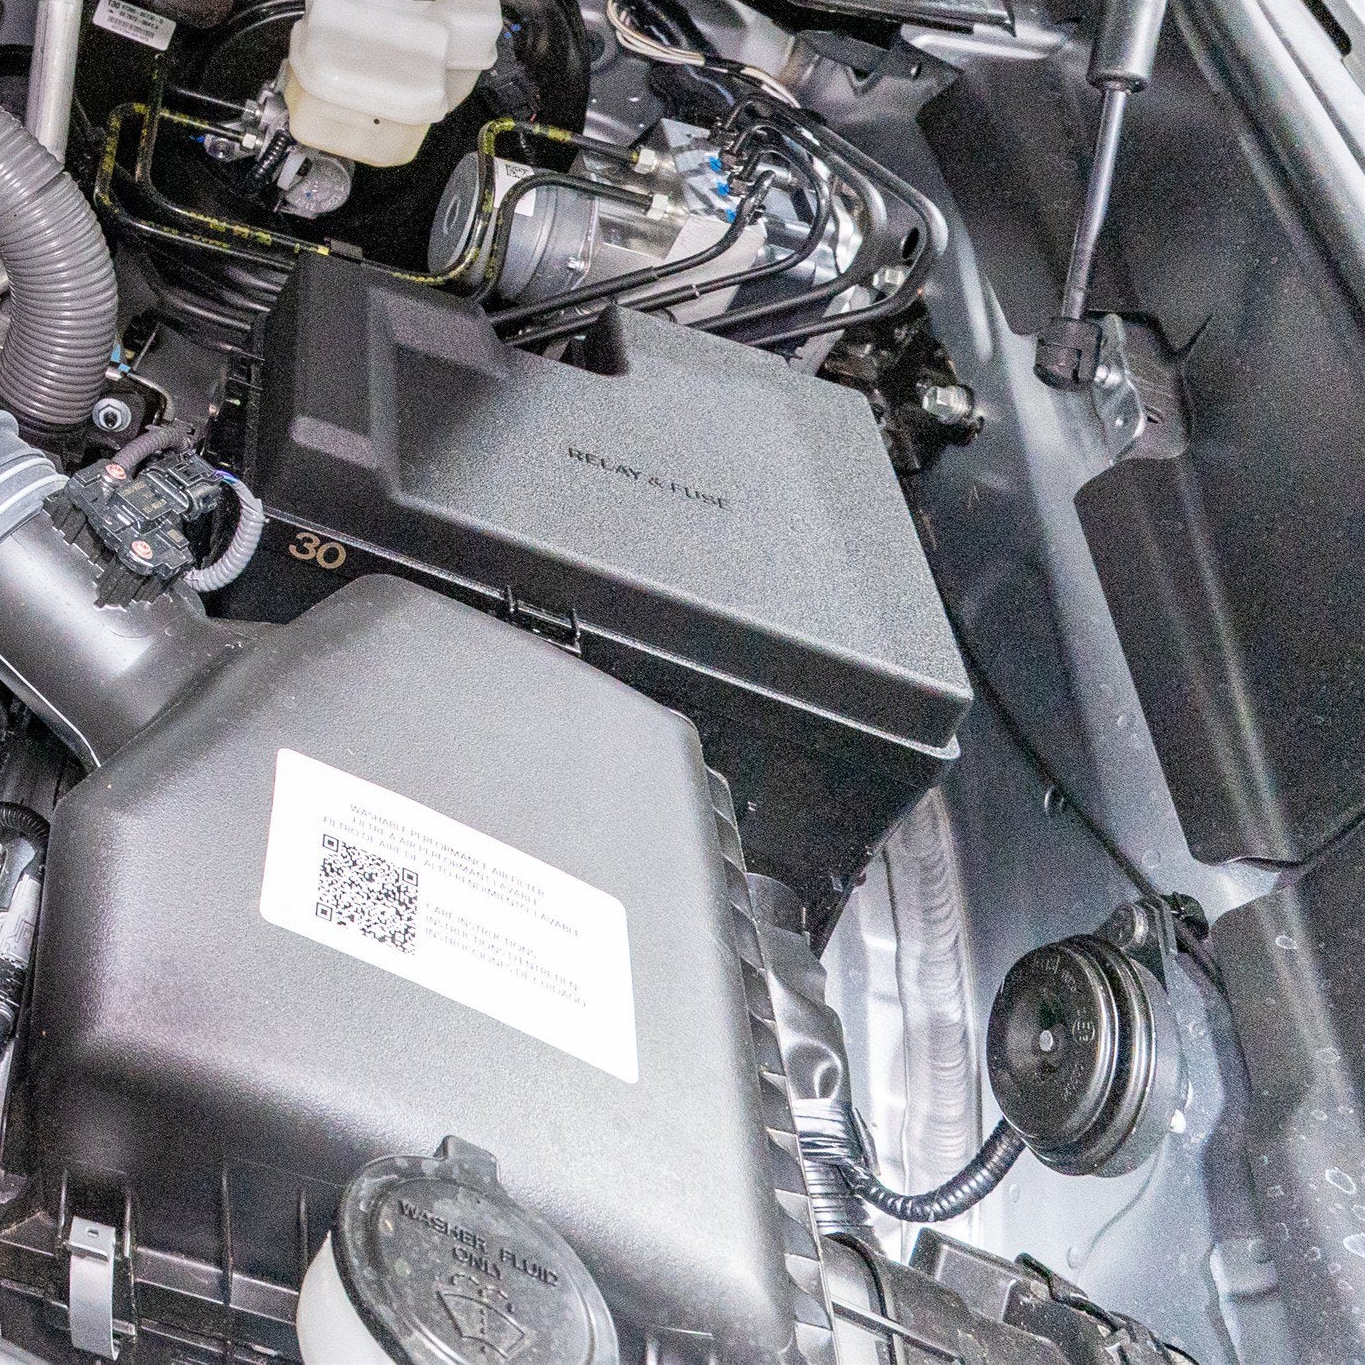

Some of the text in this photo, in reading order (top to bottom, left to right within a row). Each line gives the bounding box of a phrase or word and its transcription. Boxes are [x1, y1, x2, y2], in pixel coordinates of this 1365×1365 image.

[567, 446, 732, 510] RELAY & FUSE
[289, 532, 347, 569] 30
[323, 815, 580, 937] FILTRO DE AIRE DE ALTO RENDIMIENTO LAVABLE
[351, 803, 546, 898] WASHABLE PERFORMANCE AIR FILTER
[353, 816, 385, 835] FILTRE
[399, 837, 416, 848] AIR
[419, 846, 491, 883] PERFORMANT
[494, 881, 537, 905] LAVABLE
[426, 902, 537, 958] CARE INSTRUCTIONS
[426, 915, 505, 956] INSTRUCTIONS
[425, 928, 586, 1008] INSTRUCCIONES DE CUIDADO
[398, 1199, 560, 1289] WASHER FLUID
[452, 1245, 503, 1281] ONLY
